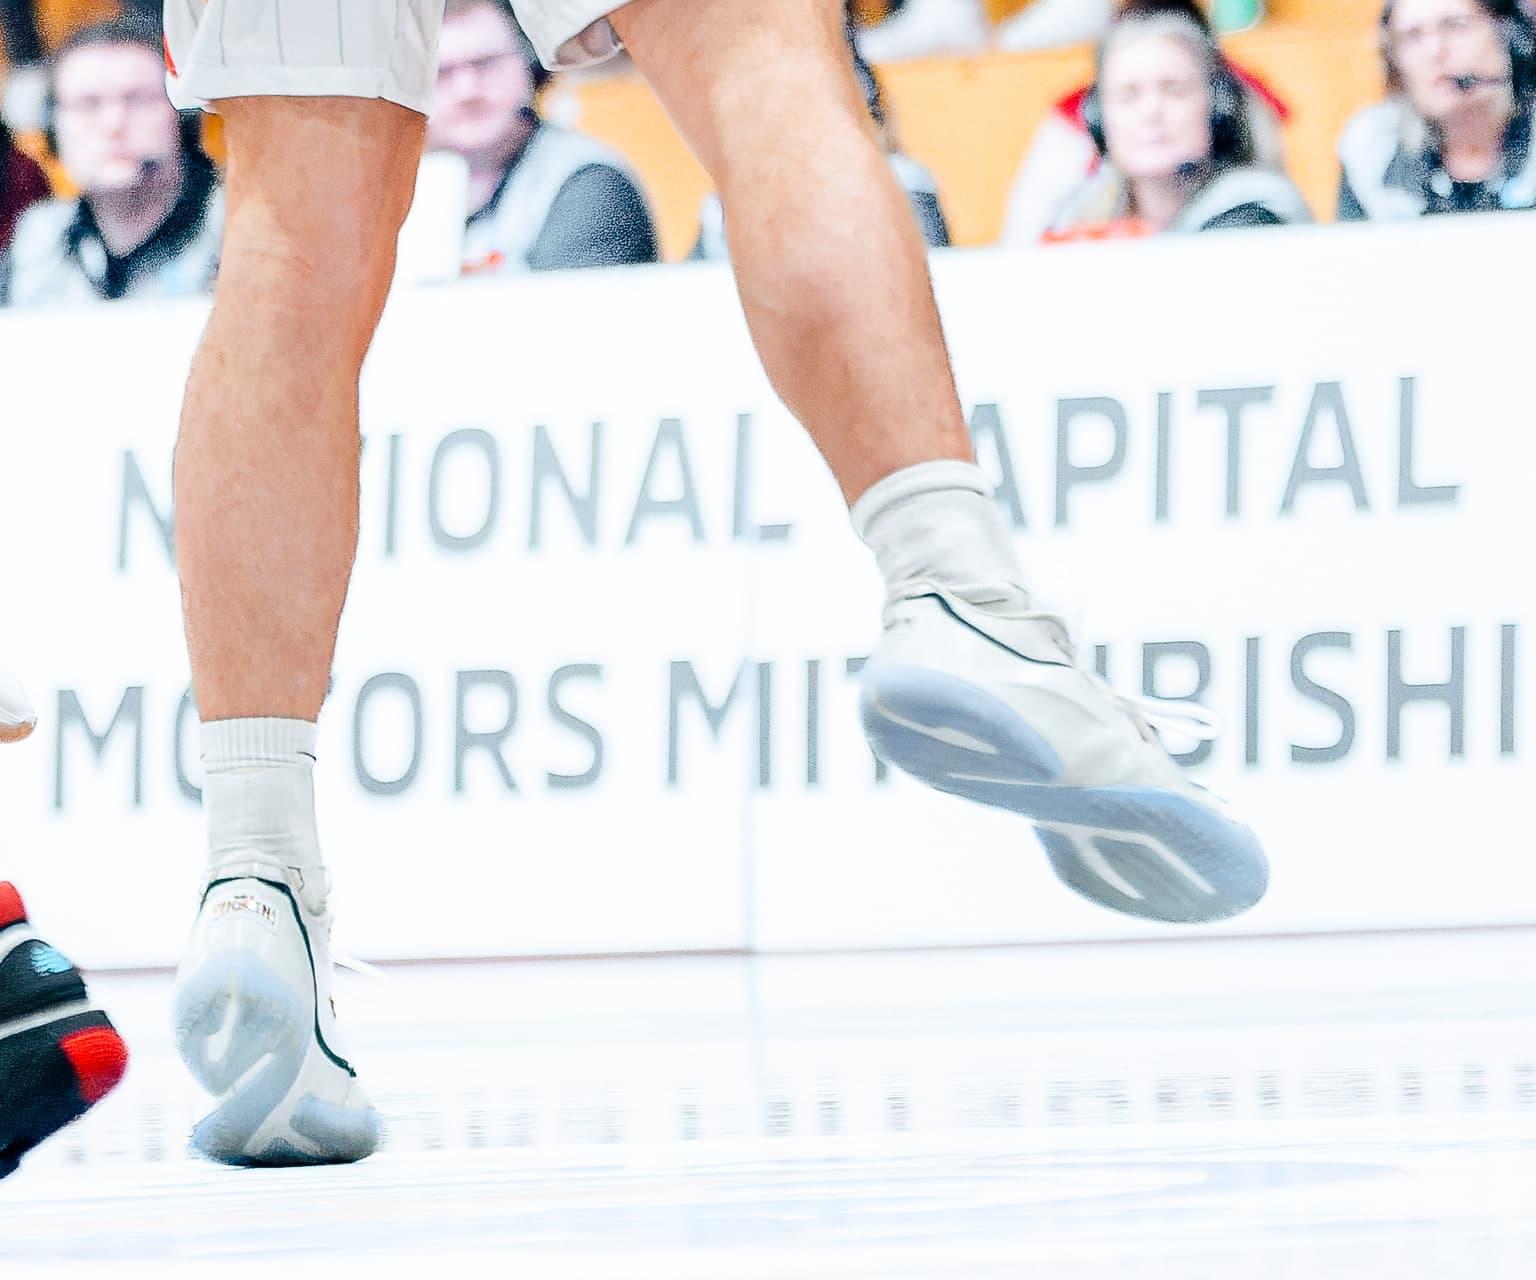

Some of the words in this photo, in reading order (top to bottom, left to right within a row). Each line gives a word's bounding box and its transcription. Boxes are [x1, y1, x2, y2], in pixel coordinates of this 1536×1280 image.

[116, 413, 792, 573] NIONAL
[967, 376, 1462, 530] APITAL
[54, 662, 604, 810] MORS
